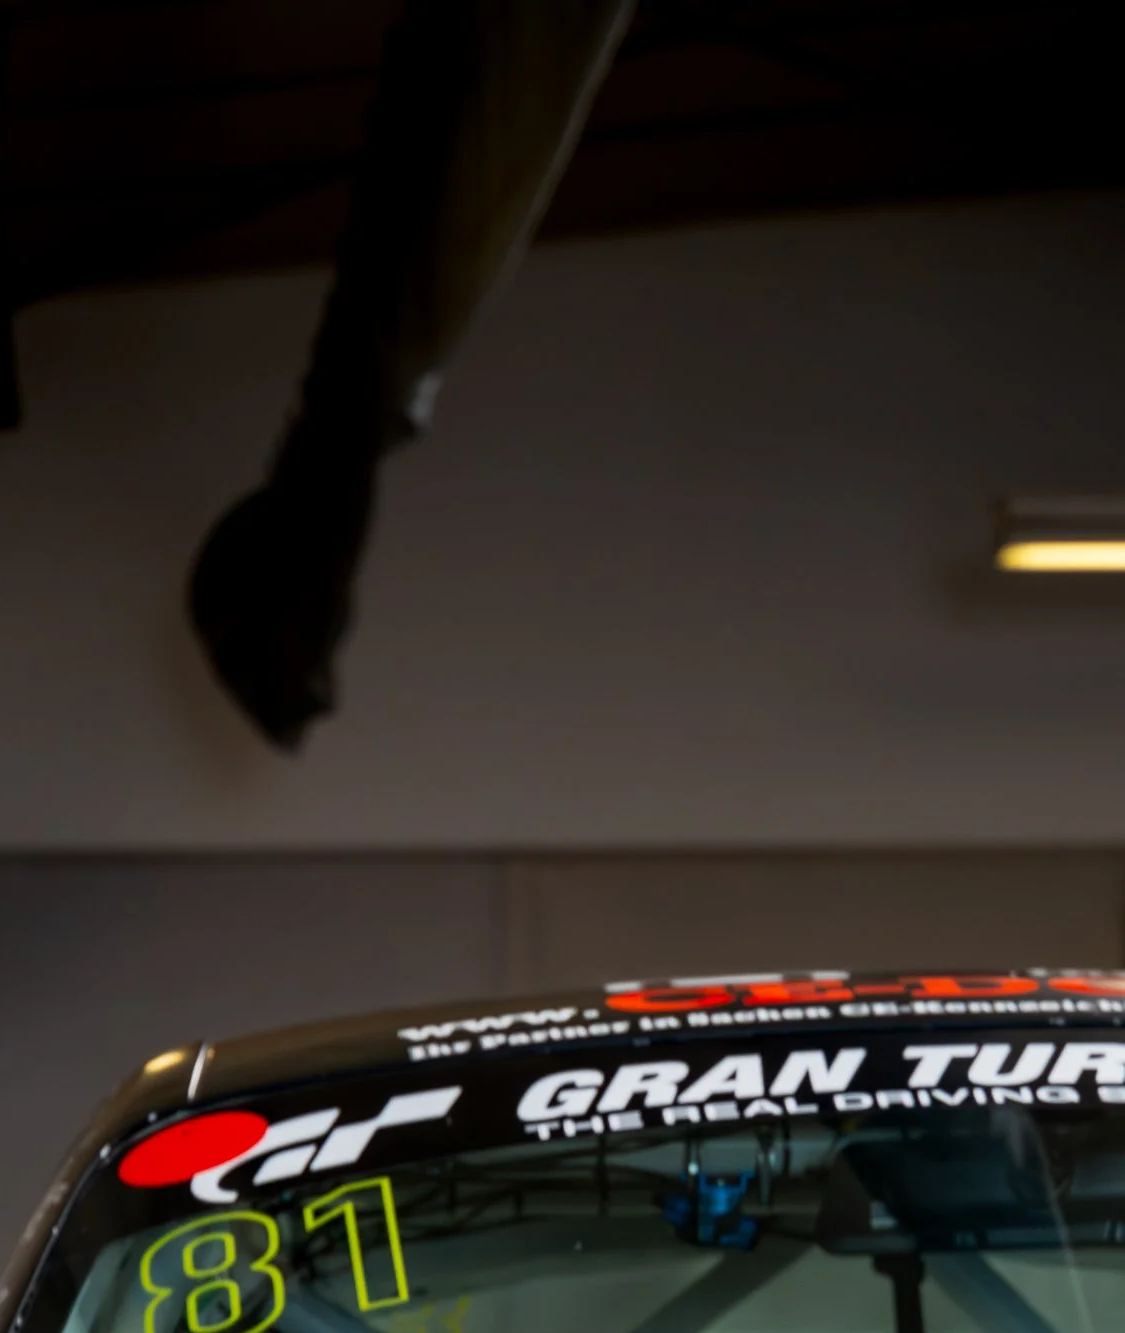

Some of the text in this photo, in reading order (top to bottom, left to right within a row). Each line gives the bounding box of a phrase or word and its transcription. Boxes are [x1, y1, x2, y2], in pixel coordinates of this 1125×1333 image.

[479, 1018, 630, 1050] Partner
[516, 1041, 1125, 1123] GRAN TUR
[523, 1108, 645, 1142] THE
[661, 1096, 820, 1127] REAL
[832, 1085, 1081, 1112] DRIVING
